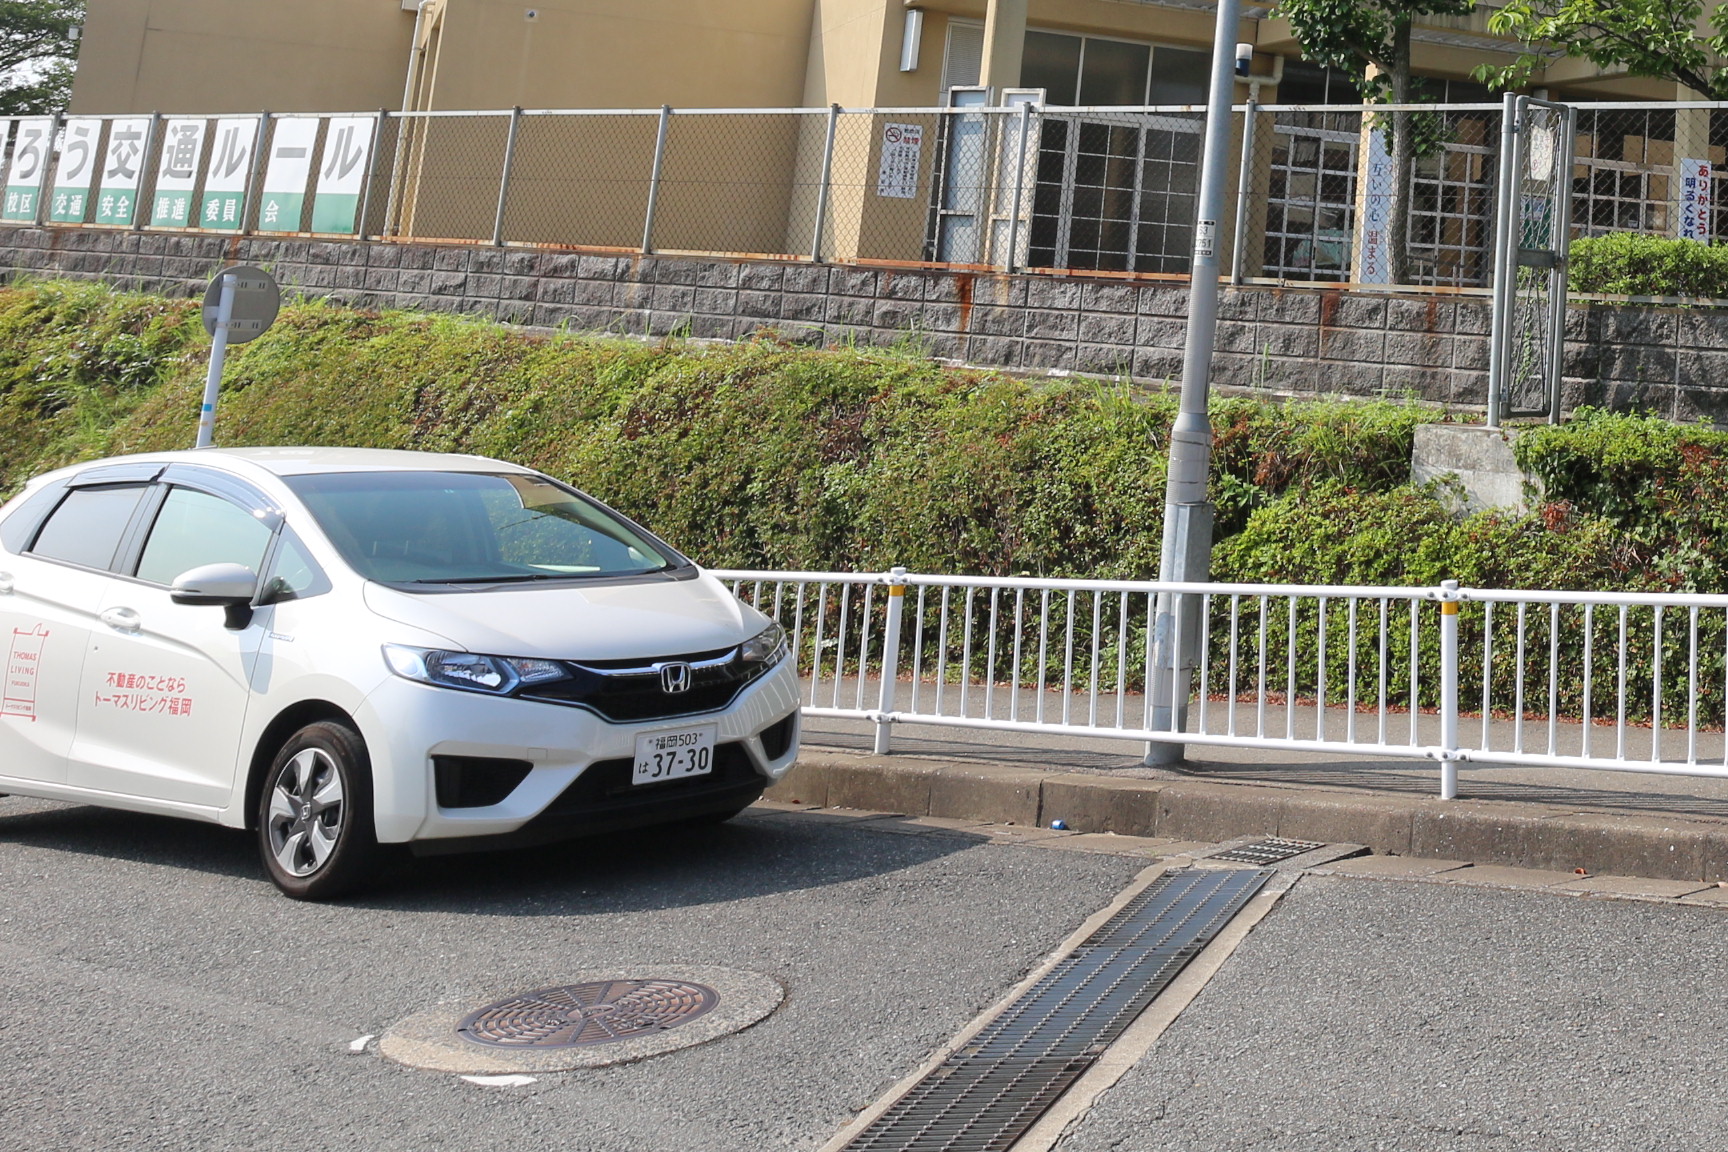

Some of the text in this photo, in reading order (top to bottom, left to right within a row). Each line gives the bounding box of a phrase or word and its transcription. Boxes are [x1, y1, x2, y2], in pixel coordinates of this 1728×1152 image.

[0, 124, 363, 181] ろう交通ルール
[1697, 164, 1709, 235] ありがとう
[13, 651, 37, 661] THOMAS
[10, 665, 35, 676] LIVING
[106, 672, 186, 694] 不動産のことなら
[94, 690, 193, 717] トーマスリビング福岡
[651, 746, 709, 778] 37-30
